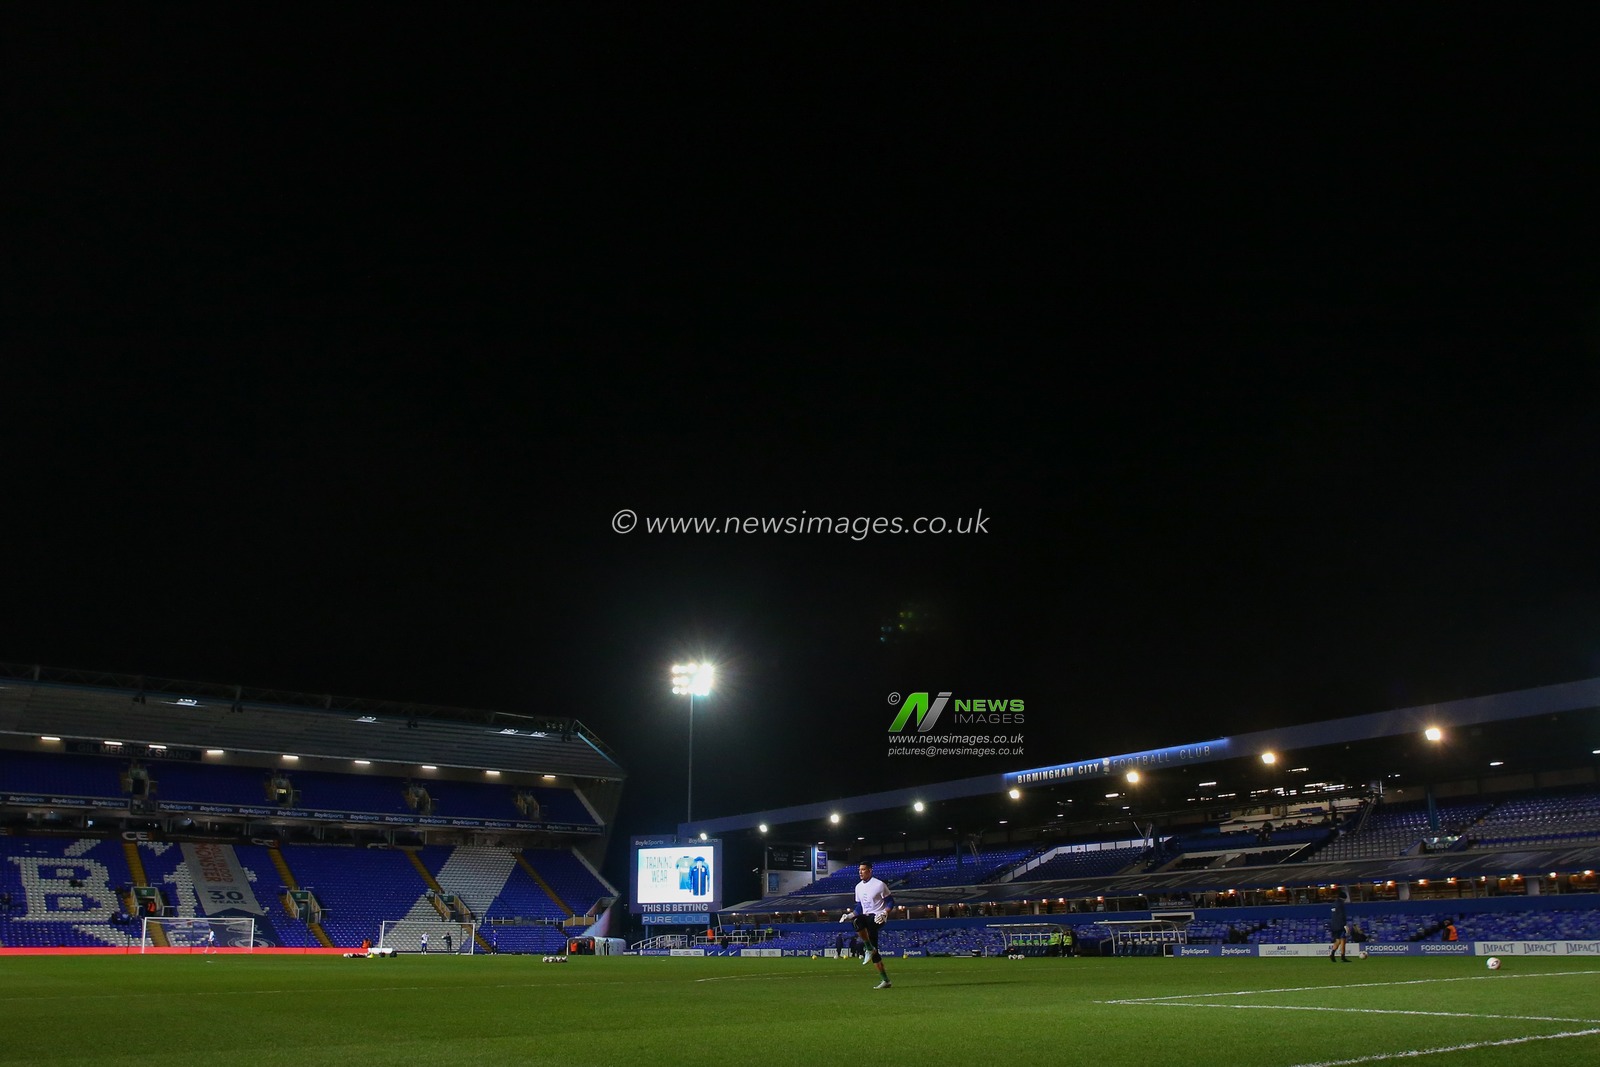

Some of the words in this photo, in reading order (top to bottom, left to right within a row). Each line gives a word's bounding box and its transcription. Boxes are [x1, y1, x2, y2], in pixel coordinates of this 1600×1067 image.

[1017, 766, 1074, 785] BIRMINGHAM
[1078, 763, 1099, 776] CITY
[1112, 752, 1171, 770] FOOTBALL
[1179, 745, 1211, 760] CLUB
[207, 890, 244, 901] 30
[642, 904, 662, 912] THIS
[672, 903, 709, 912] BETTING
[1181, 946, 1209, 955] BoyleSports
[1221, 945, 1250, 955] BoyleSports
[1365, 944, 1409, 952] FORDROUGH
[1421, 944, 1468, 952] FORDROUGH
[1483, 942, 1515, 955] IMPACT
[1524, 942, 1557, 954] IMPACT
[1566, 941, 1600, 953] IMPACT
